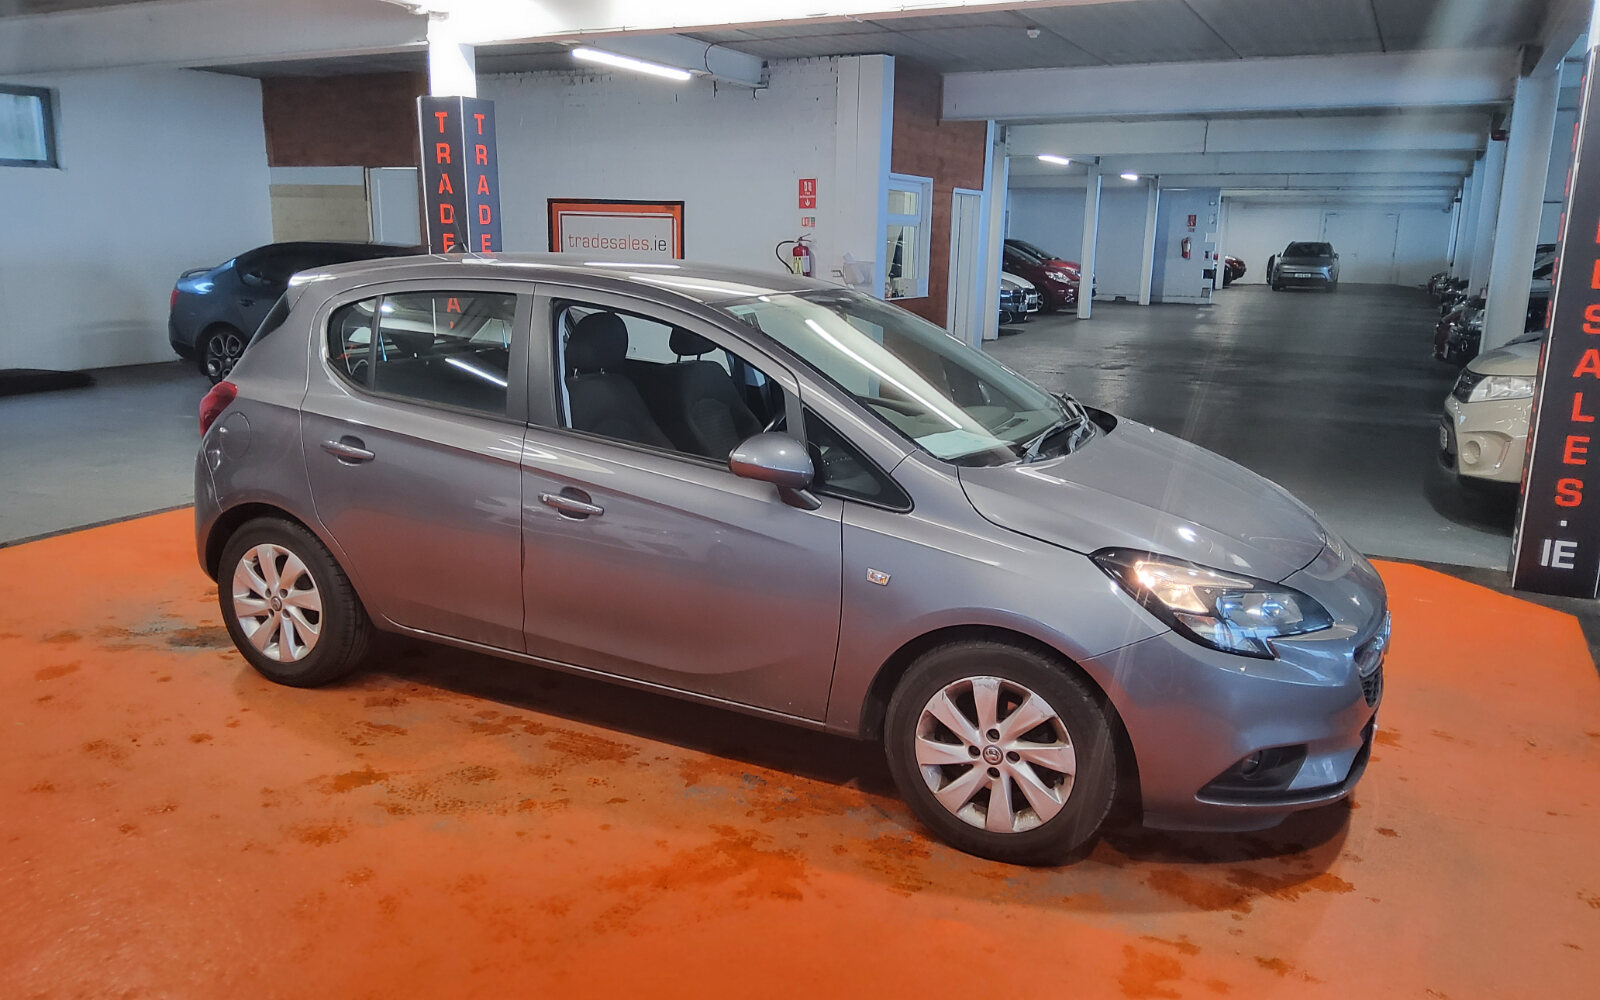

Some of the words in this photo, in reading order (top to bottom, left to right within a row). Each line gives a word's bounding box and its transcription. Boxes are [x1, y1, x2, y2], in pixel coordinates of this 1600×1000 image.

[474, 114, 492, 253] TRADE
[568, 233, 667, 251] tradesales.ie
[1540, 217, 1600, 569] SALES.IE
